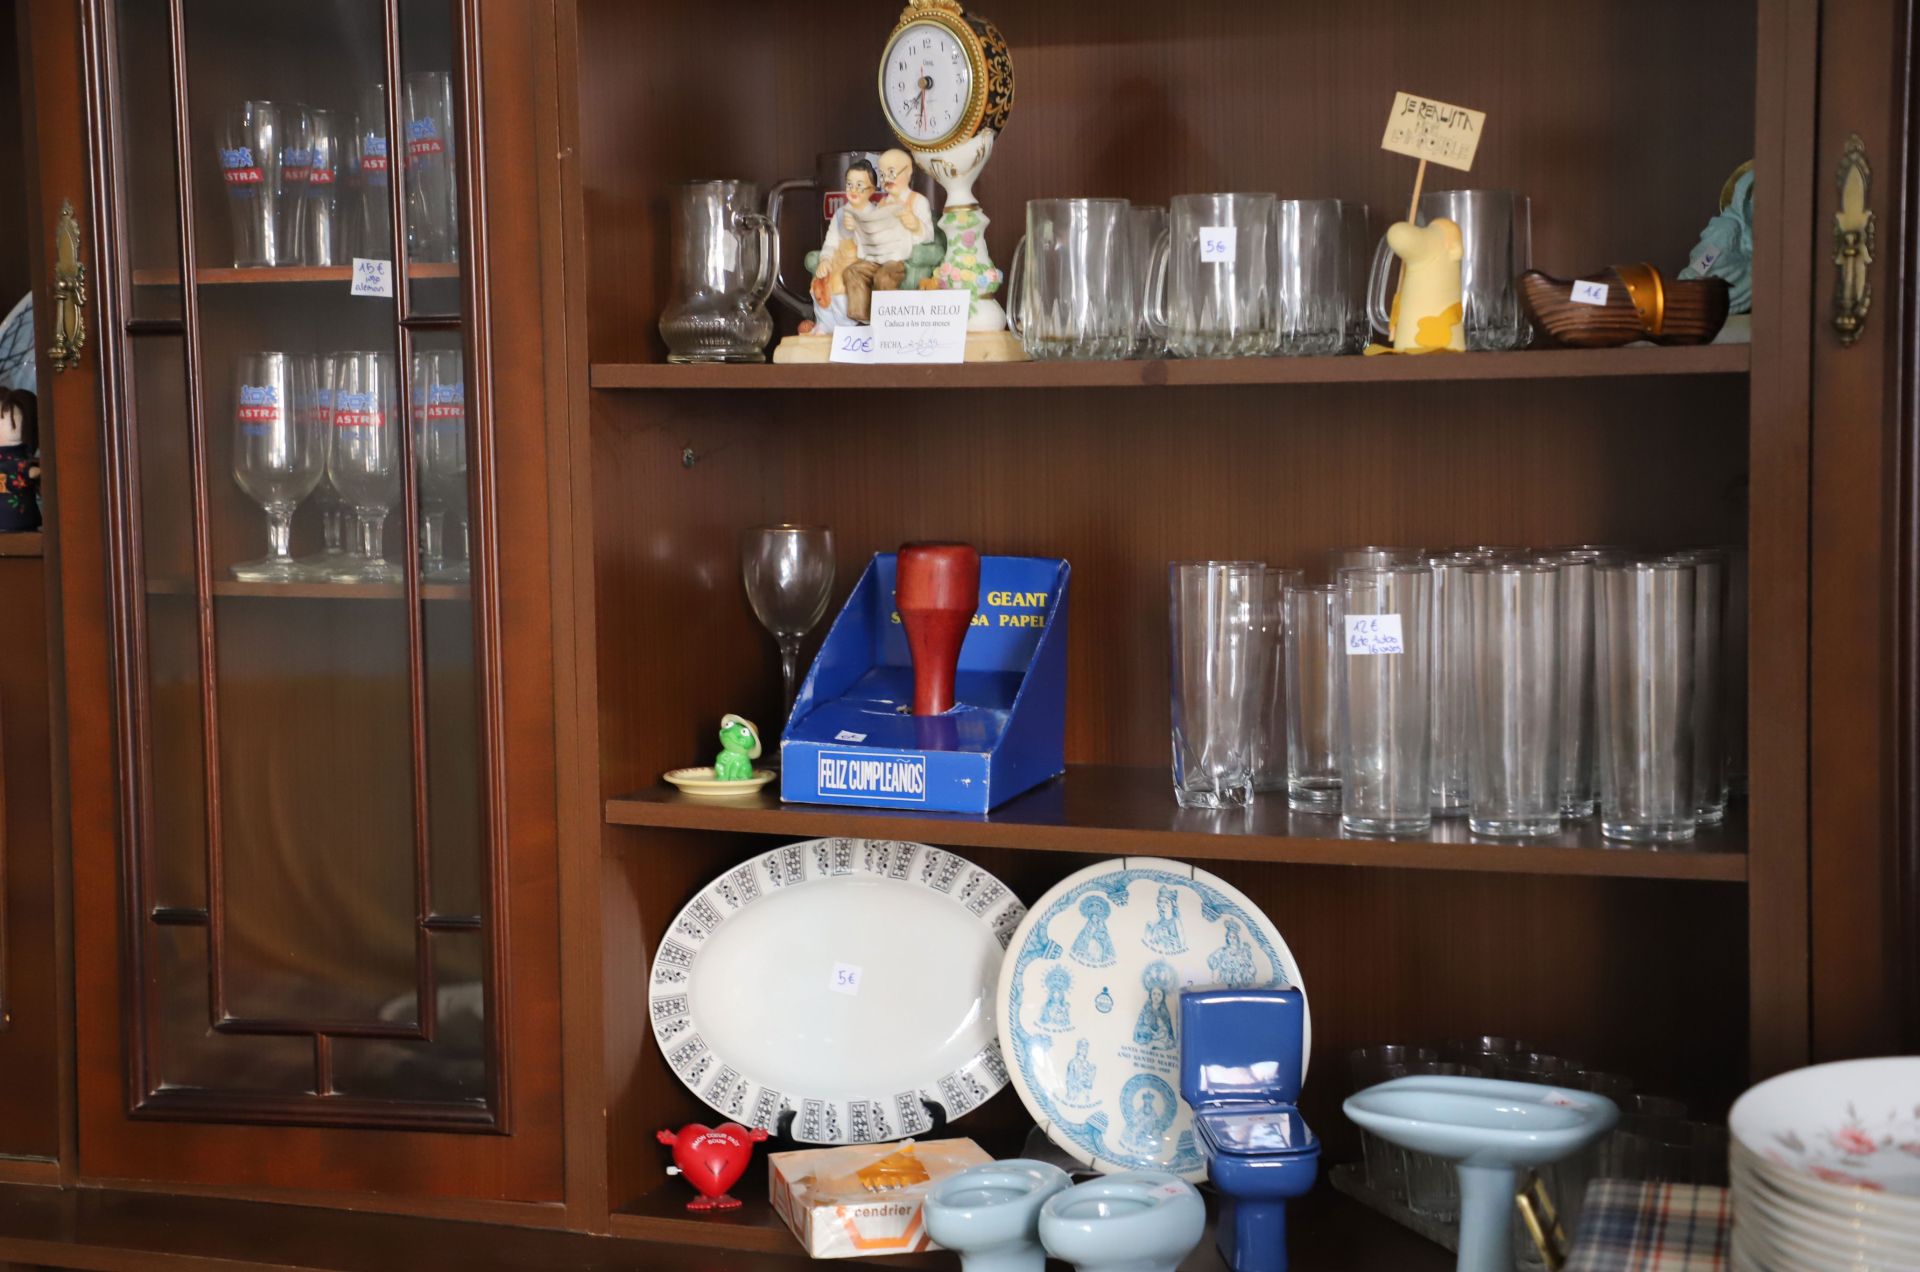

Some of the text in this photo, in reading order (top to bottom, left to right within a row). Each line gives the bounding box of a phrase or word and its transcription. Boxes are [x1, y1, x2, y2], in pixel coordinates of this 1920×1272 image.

[878, 304, 961, 316] GARANTIA RELOJ
[841, 335, 873, 353] 20€
[880, 340, 902, 350] FECHA
[239, 406, 278, 418] ASTRA
[336, 414, 382, 425] ASTRA
[987, 591, 1048, 607] GEANT
[999, 615, 1045, 627] PAPEL
[820, 758, 923, 794] FELIZ CUMPLEAÑOS
[837, 969, 856, 985] 5€
[854, 1204, 912, 1218] cendrier
